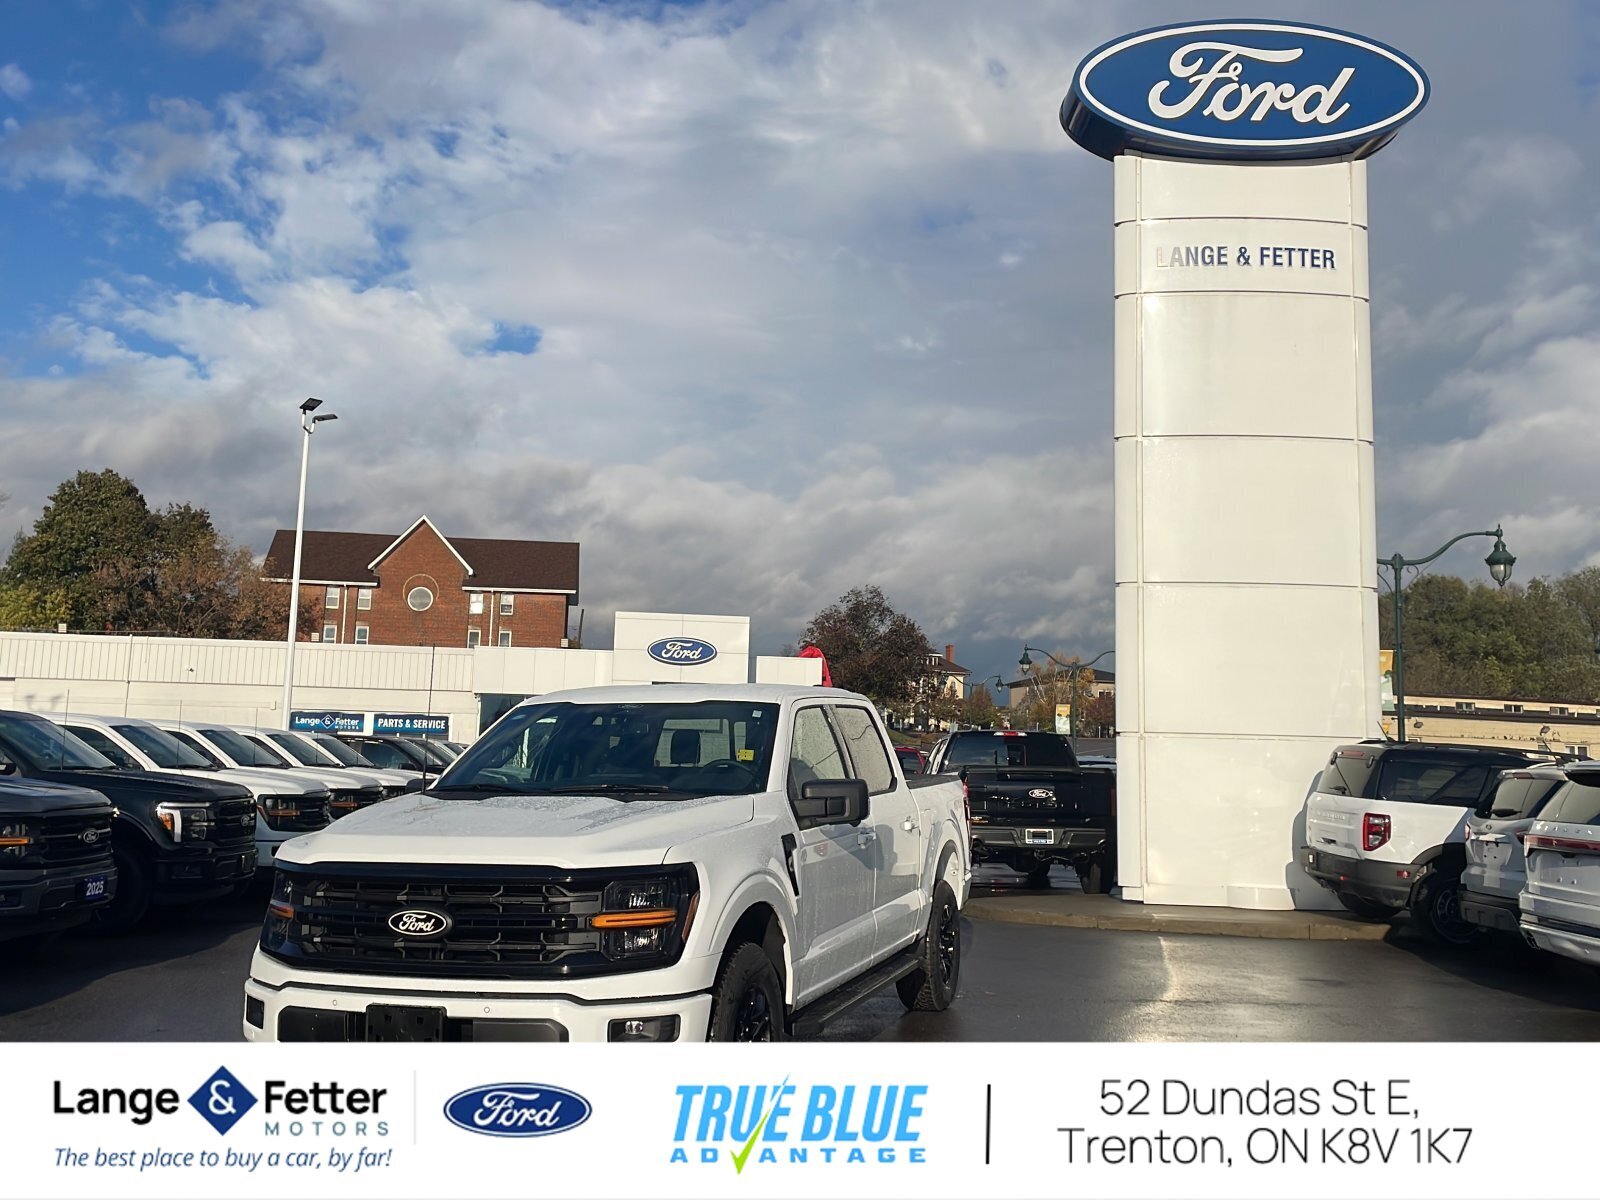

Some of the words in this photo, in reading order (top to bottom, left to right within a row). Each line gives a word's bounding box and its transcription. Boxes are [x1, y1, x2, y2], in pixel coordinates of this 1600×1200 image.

[1148, 42, 1355, 124] Ford
[1156, 246, 1228, 267] LANGE
[1236, 246, 1251, 267] &
[1260, 246, 1336, 269] FETTER
[661, 641, 703, 659] Ford
[295, 716, 320, 727] Lange
[335, 717, 360, 726] Fetter
[377, 718, 403, 728] PARTS
[405, 718, 411, 728] &
[413, 719, 446, 729] SERVICE
[86, 881, 104, 896] 2025
[398, 913, 436, 931] Ford
